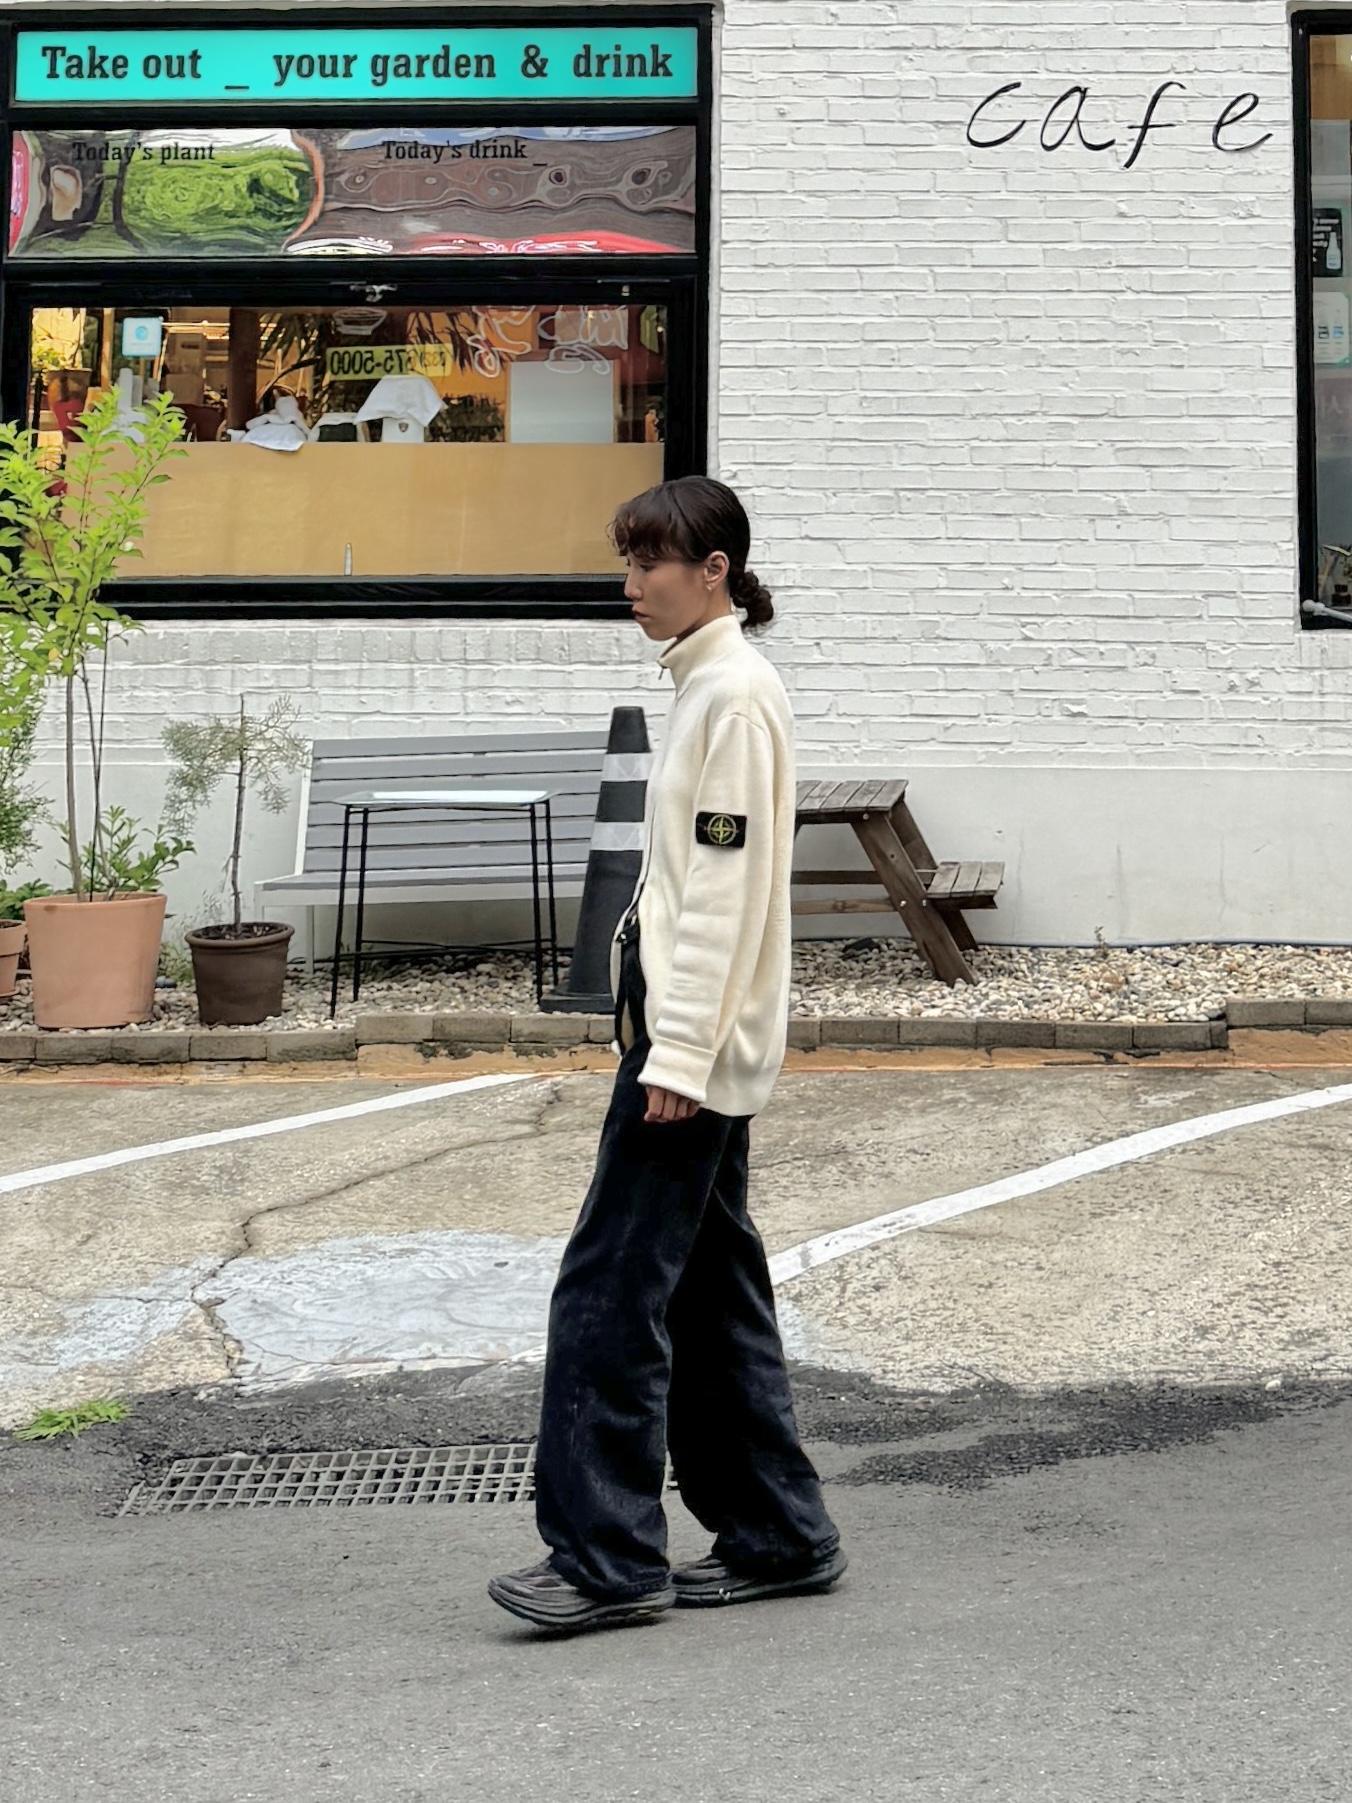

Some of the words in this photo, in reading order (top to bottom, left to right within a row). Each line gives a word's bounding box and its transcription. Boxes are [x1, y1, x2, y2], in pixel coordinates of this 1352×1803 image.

[41, 45, 129, 79] Take
[142, 49, 202, 79] out
[273, 53, 357, 86] your
[371, 44, 496, 87] garden
[520, 44, 548, 78] &
[572, 44, 673, 78] drink
[967, 81, 1274, 170] cafe
[72, 142, 153, 165] Today's
[160, 142, 215, 165] plant
[382, 140, 462, 164] Today's
[469, 139, 527, 159] drink
